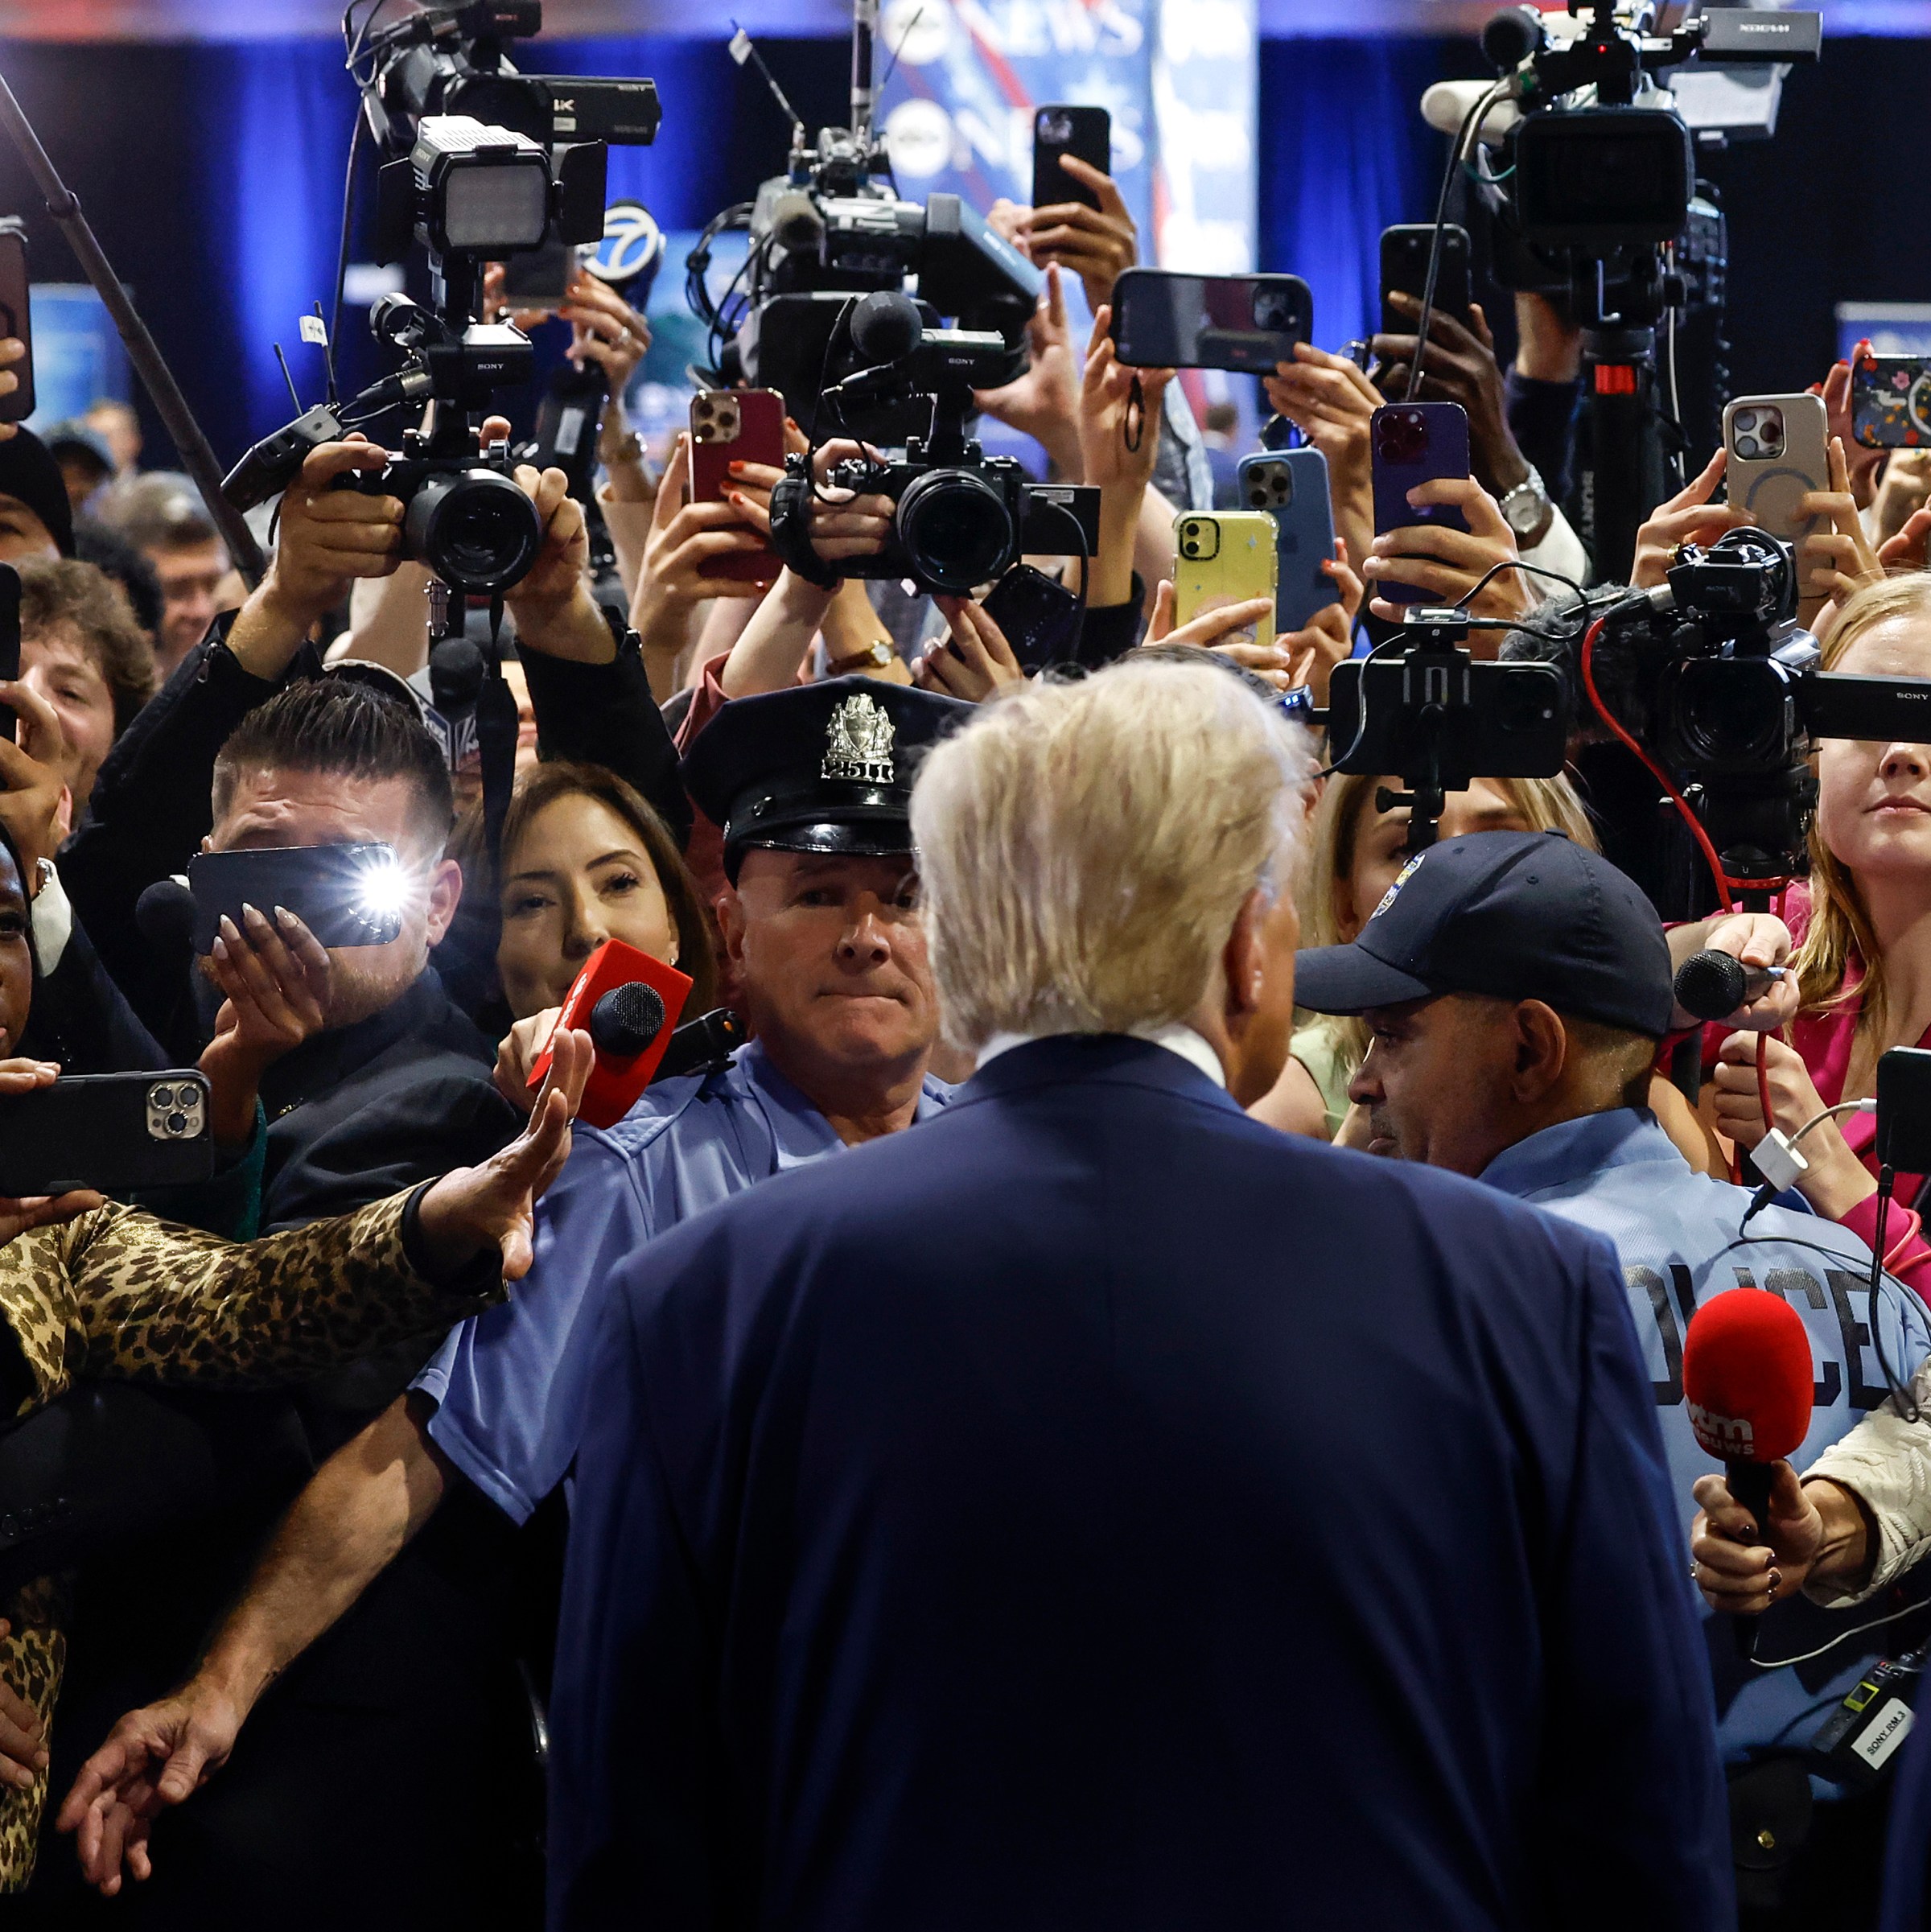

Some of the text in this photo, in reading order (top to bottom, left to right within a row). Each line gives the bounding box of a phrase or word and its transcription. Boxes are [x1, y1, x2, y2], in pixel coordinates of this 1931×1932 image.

[948, 357, 975, 365] SONY
[1896, 692, 1929, 700] SONY
[827, 759, 884, 783] 2511
[1867, 1730, 1888, 1755] SONY
